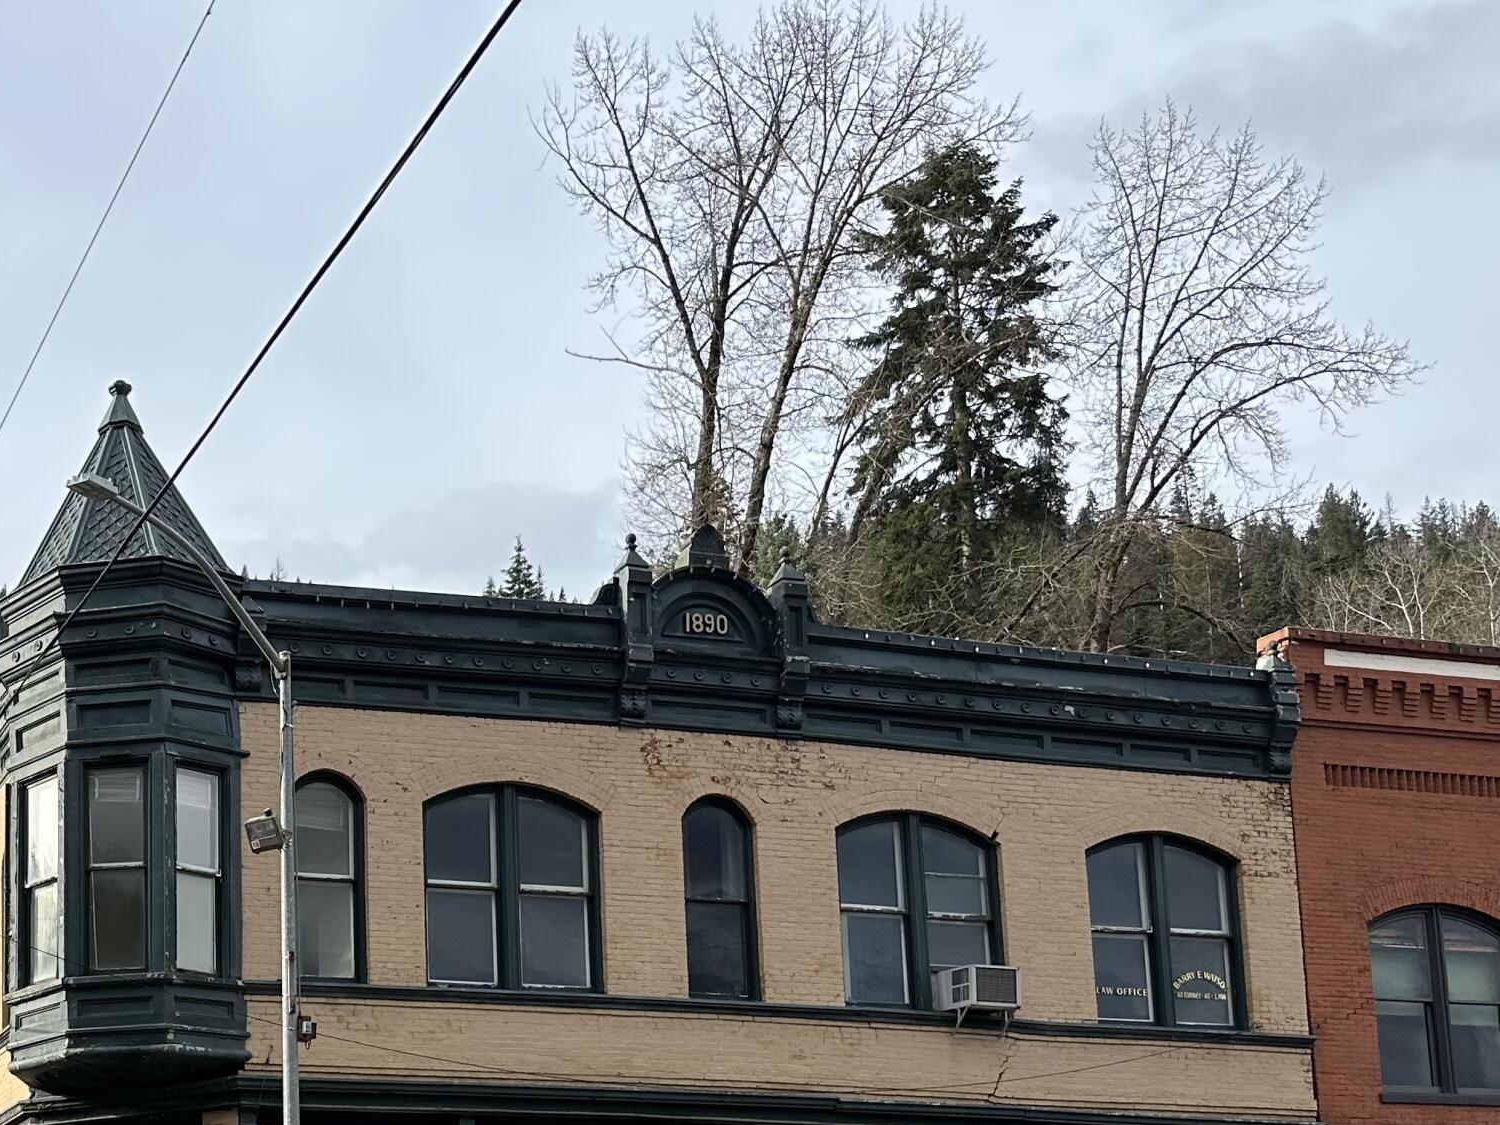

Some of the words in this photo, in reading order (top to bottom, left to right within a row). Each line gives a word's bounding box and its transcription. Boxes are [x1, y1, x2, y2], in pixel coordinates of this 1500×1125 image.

[686, 612, 728, 634] 1890
[1172, 971, 1196, 990] BARRY
[1197, 970, 1203, 979] E
[1203, 971, 1227, 990] WATSO
[1096, 986, 1114, 995] LAW
[1116, 987, 1148, 997] OFFICE
